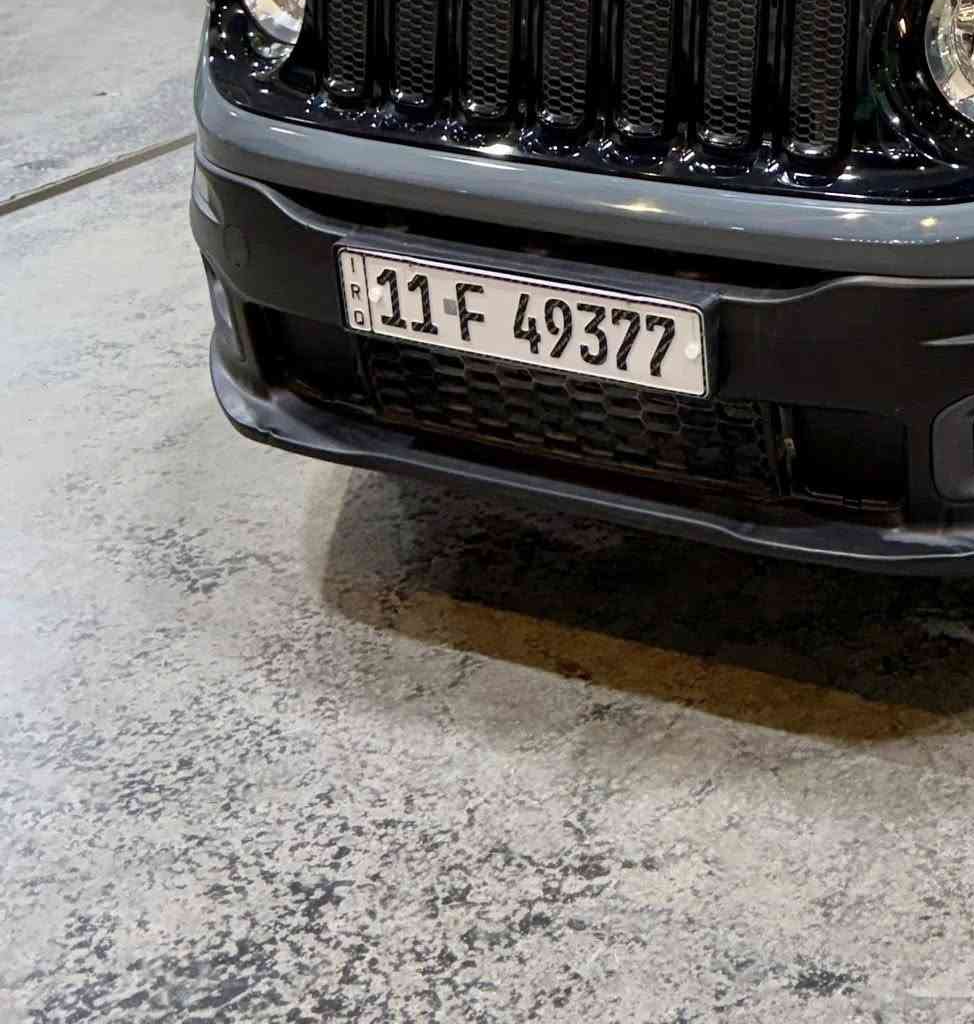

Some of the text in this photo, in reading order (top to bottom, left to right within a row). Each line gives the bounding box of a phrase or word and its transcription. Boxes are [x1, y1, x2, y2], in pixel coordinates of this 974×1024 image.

[349, 256, 365, 326] IRQ
[376, 268, 676, 377] 11 F 49377
